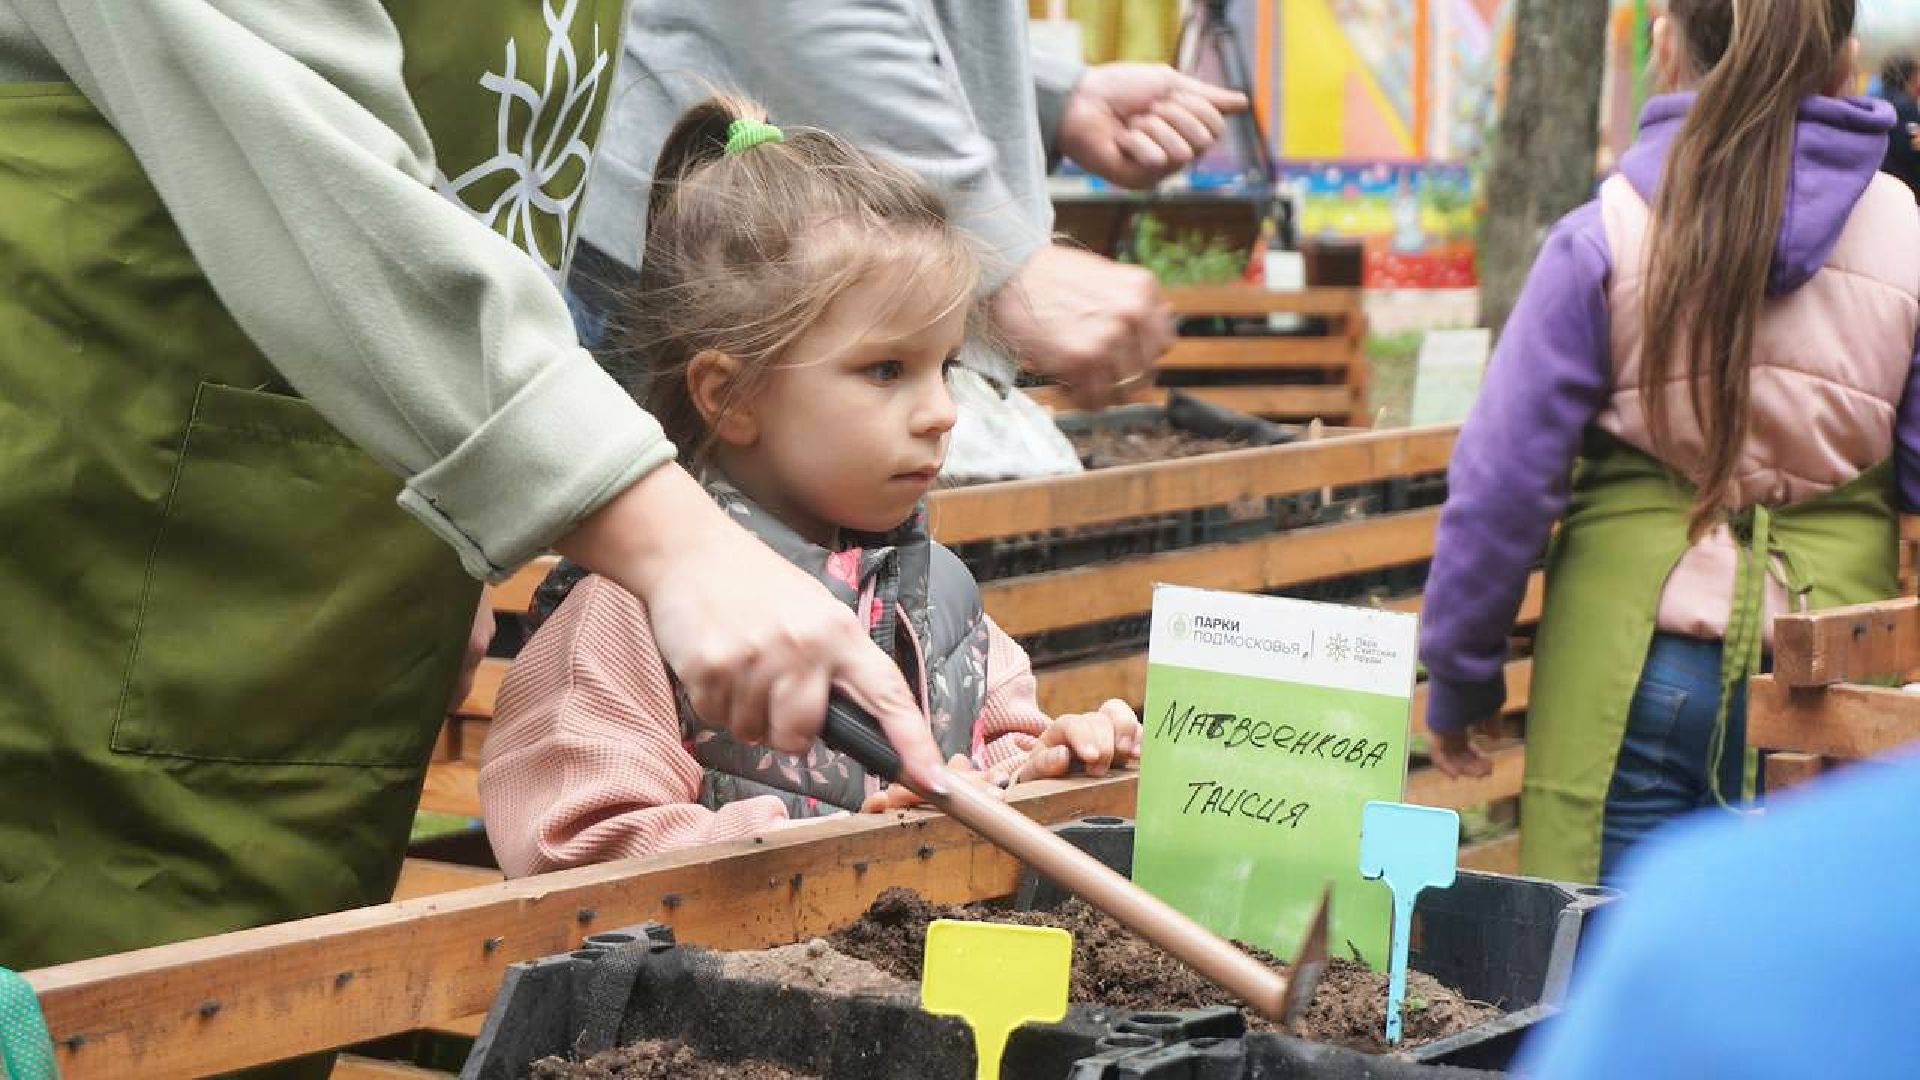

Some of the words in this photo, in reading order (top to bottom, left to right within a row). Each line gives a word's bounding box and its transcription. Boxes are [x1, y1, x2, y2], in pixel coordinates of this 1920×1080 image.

[1194, 615, 1240, 632] ПАРКИ
[1193, 630, 1301, 655] ПОДМОСКОВЬЯ
[1182, 780, 1310, 829] ТАИСИЯ
